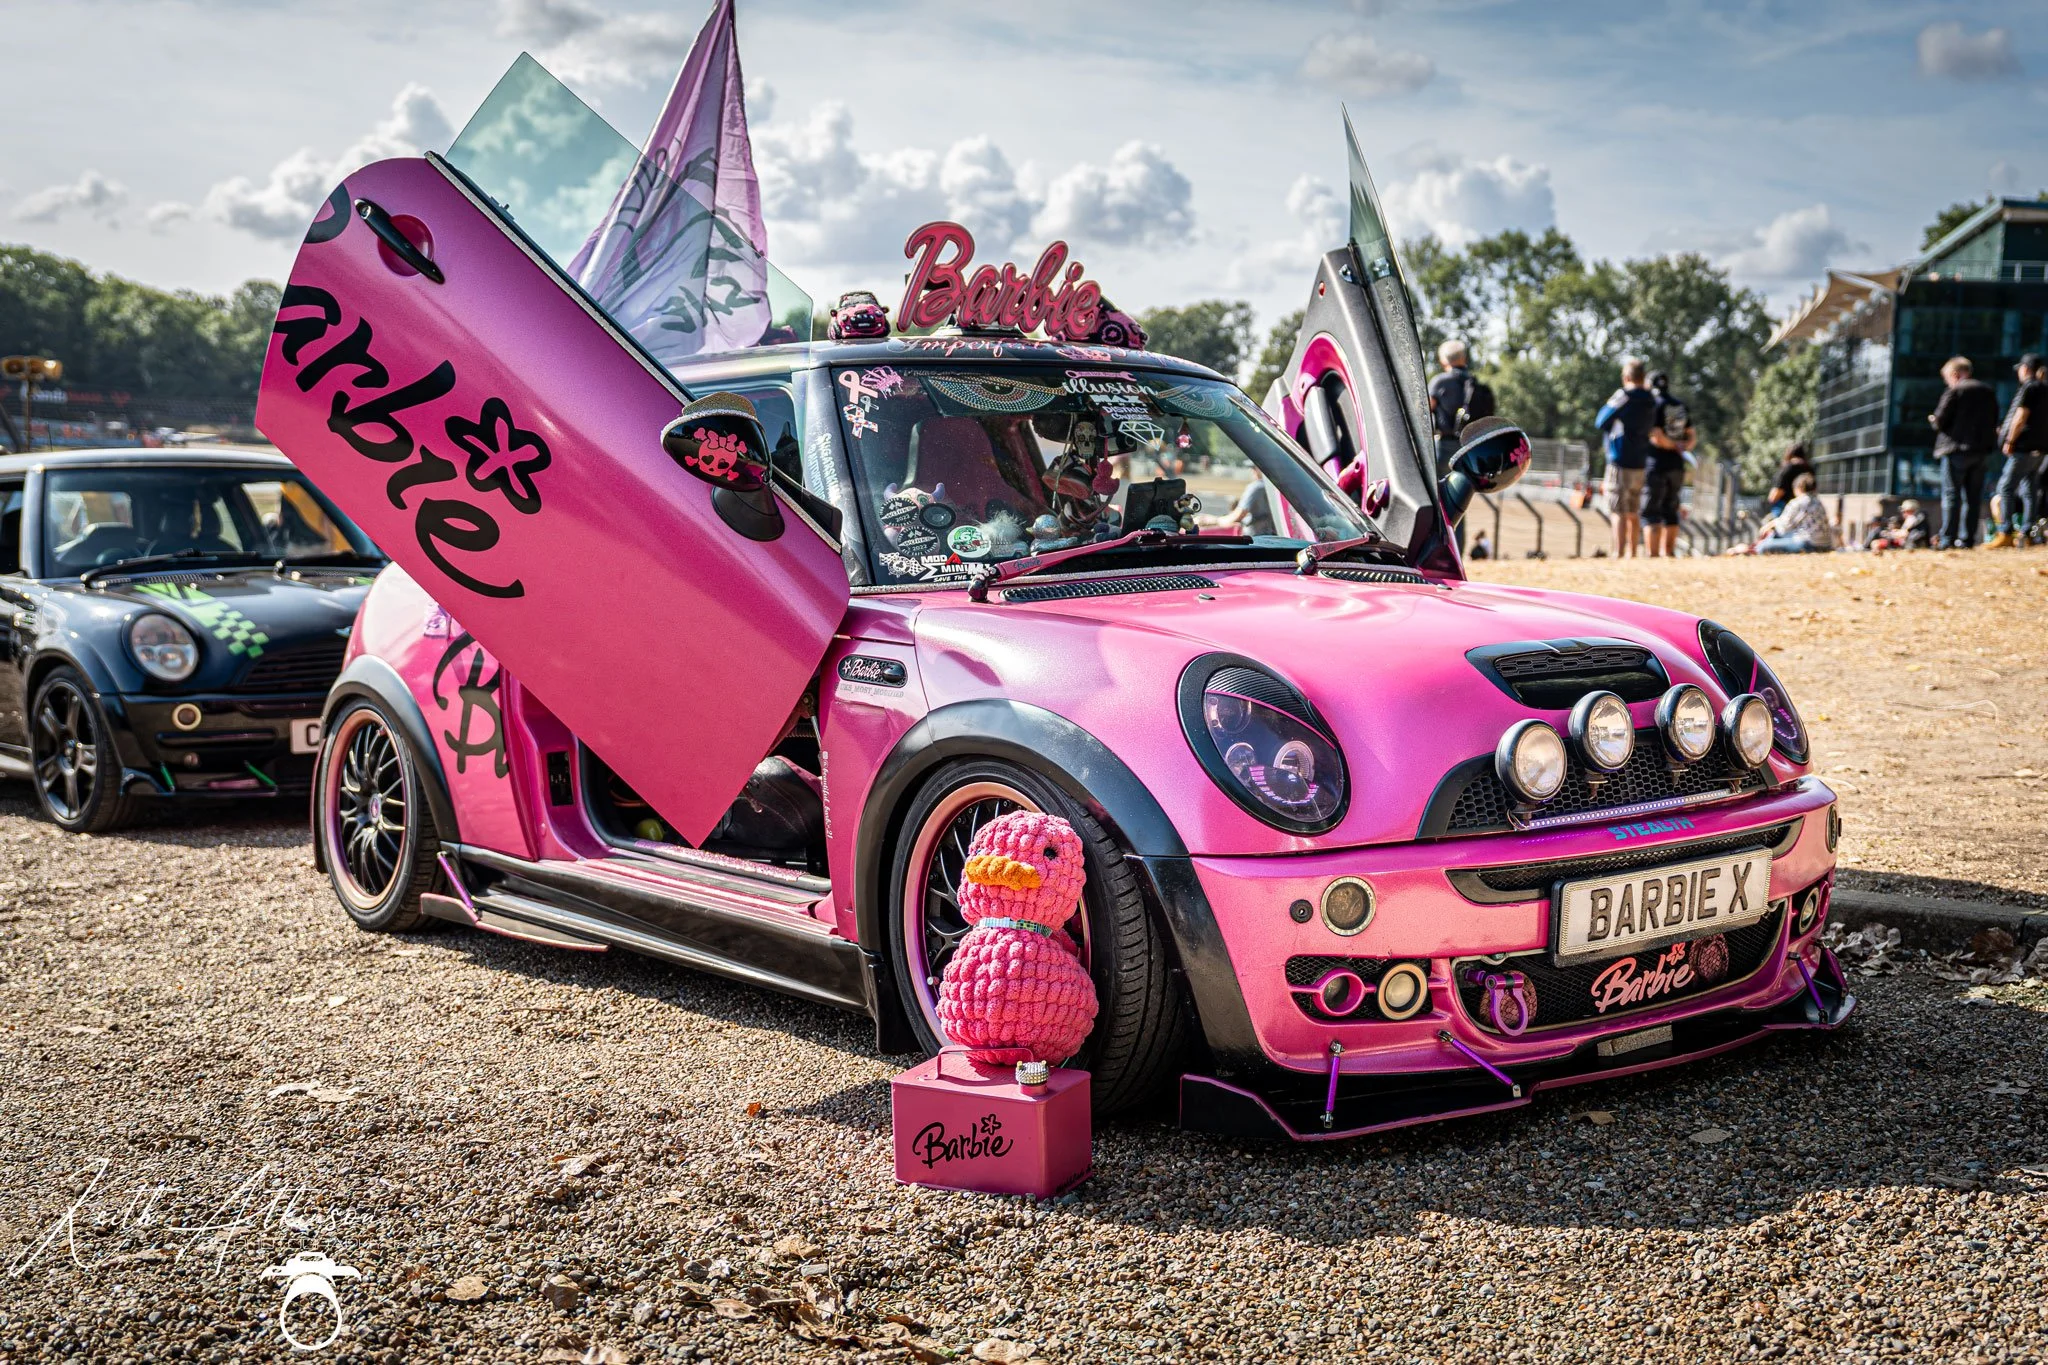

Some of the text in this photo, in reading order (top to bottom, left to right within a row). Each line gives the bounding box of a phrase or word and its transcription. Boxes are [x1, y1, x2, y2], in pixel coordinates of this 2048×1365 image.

[896, 220, 1101, 340] Barbie
[1062, 378, 1159, 396] illusion
[895, 513, 910, 522] 2022
[912, 543, 928, 551] 2022
[920, 554, 948, 564] MOD
[933, 575, 951, 583] SAVE
[850, 658, 881, 679] Barbie
[1607, 815, 1695, 841] STEALTH
[1587, 861, 1753, 942] BARBIE X
[1590, 943, 1695, 1014] Barbie
[911, 1115, 1014, 1170] Barbie
